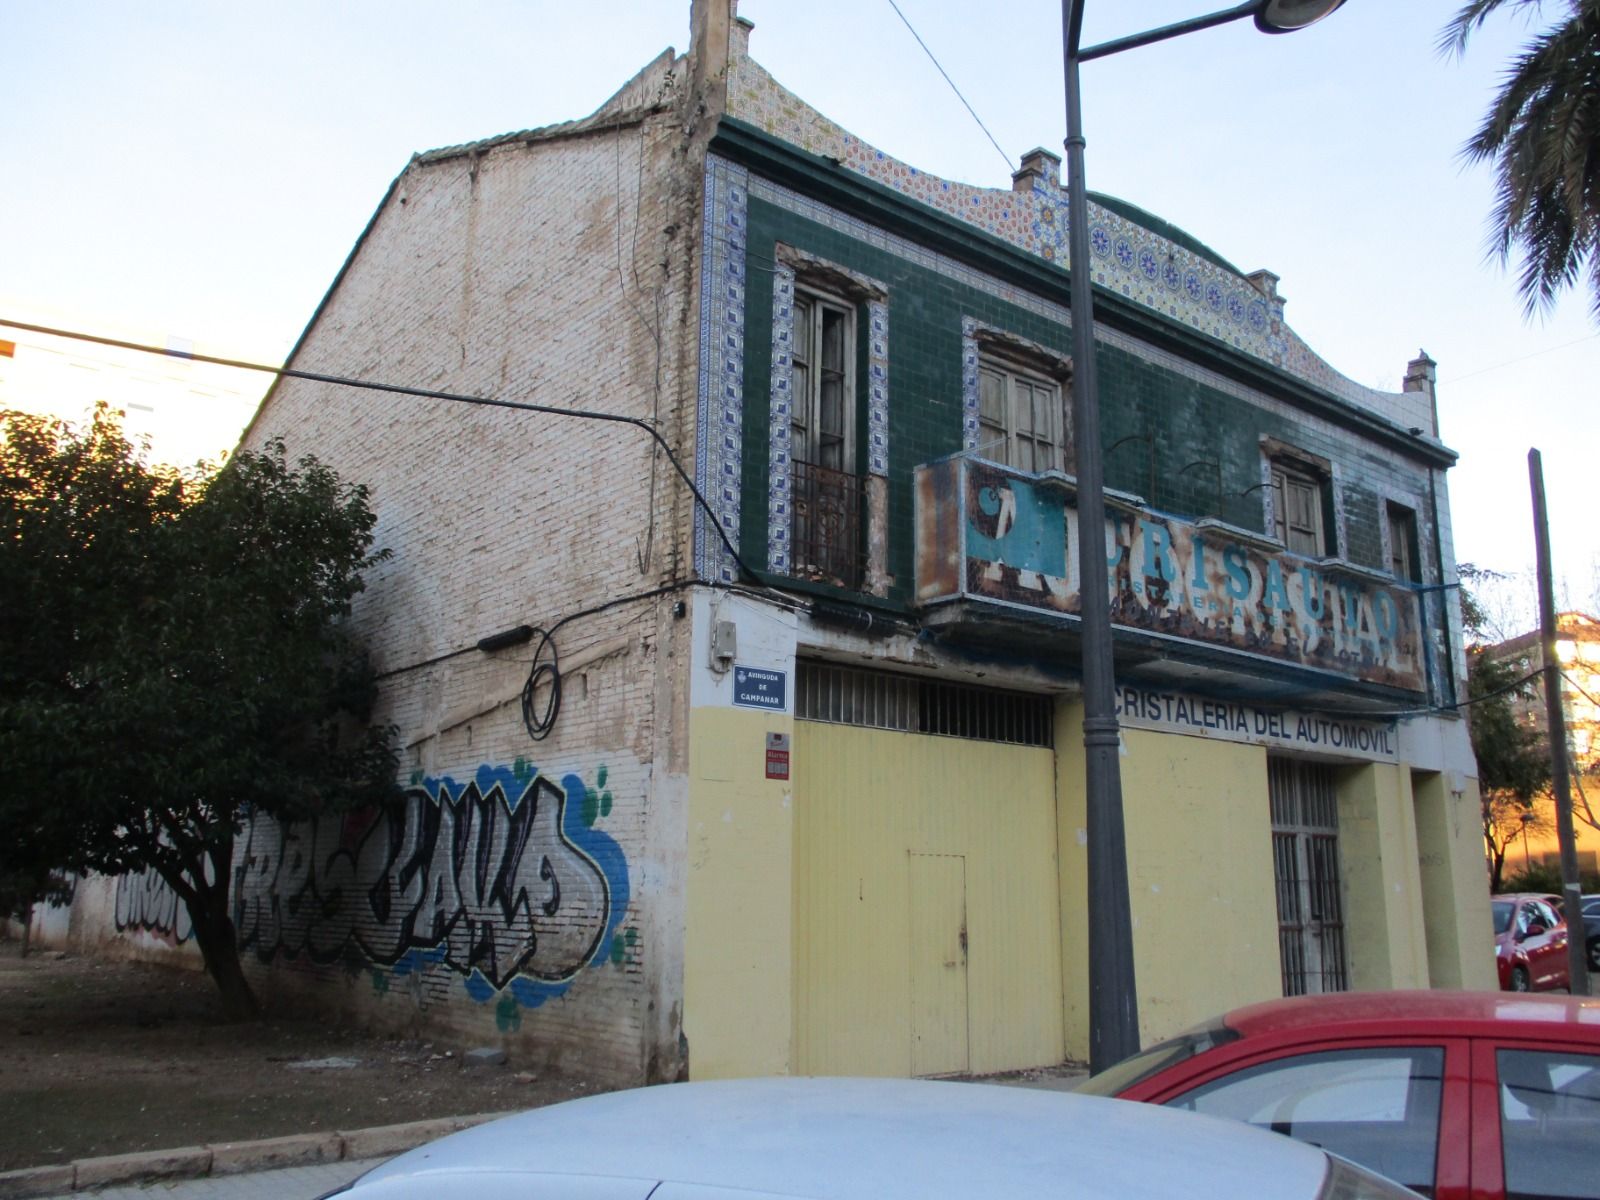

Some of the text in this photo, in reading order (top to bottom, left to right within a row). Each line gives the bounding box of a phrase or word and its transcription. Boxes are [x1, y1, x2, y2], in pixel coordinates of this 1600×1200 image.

[747, 671, 779, 682] AVINGUDA
[758, 684, 768, 692] DE
[740, 693, 780, 705] CAMPANAR
[1114, 687, 1394, 754] CRISTALERIA DEL AUTOMOVIL
